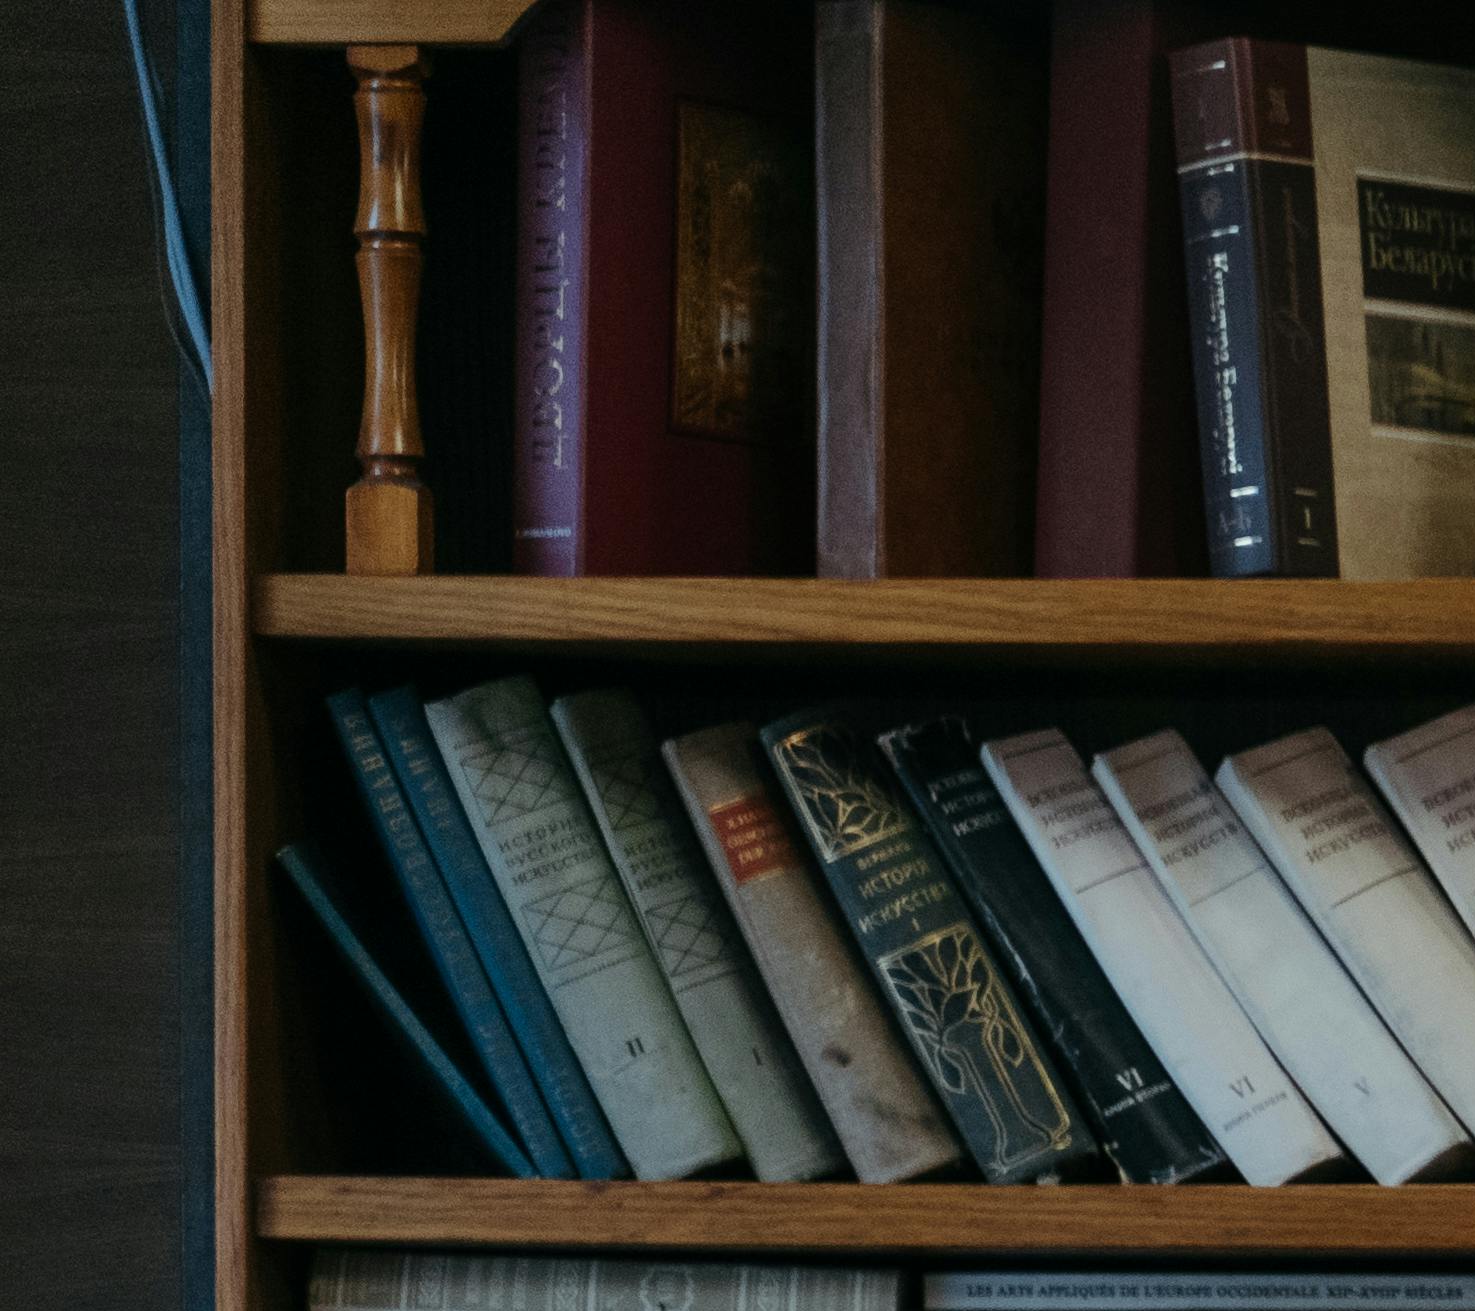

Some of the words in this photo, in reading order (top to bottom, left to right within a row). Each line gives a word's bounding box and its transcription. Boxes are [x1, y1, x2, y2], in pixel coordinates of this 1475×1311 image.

[1115, 1066, 1144, 1093] VI
[1231, 1076, 1257, 1099] VI
[967, 1283, 993, 1296] LES
[997, 1283, 1034, 1297] ARTS
[1120, 1285, 1139, 1298] DE
